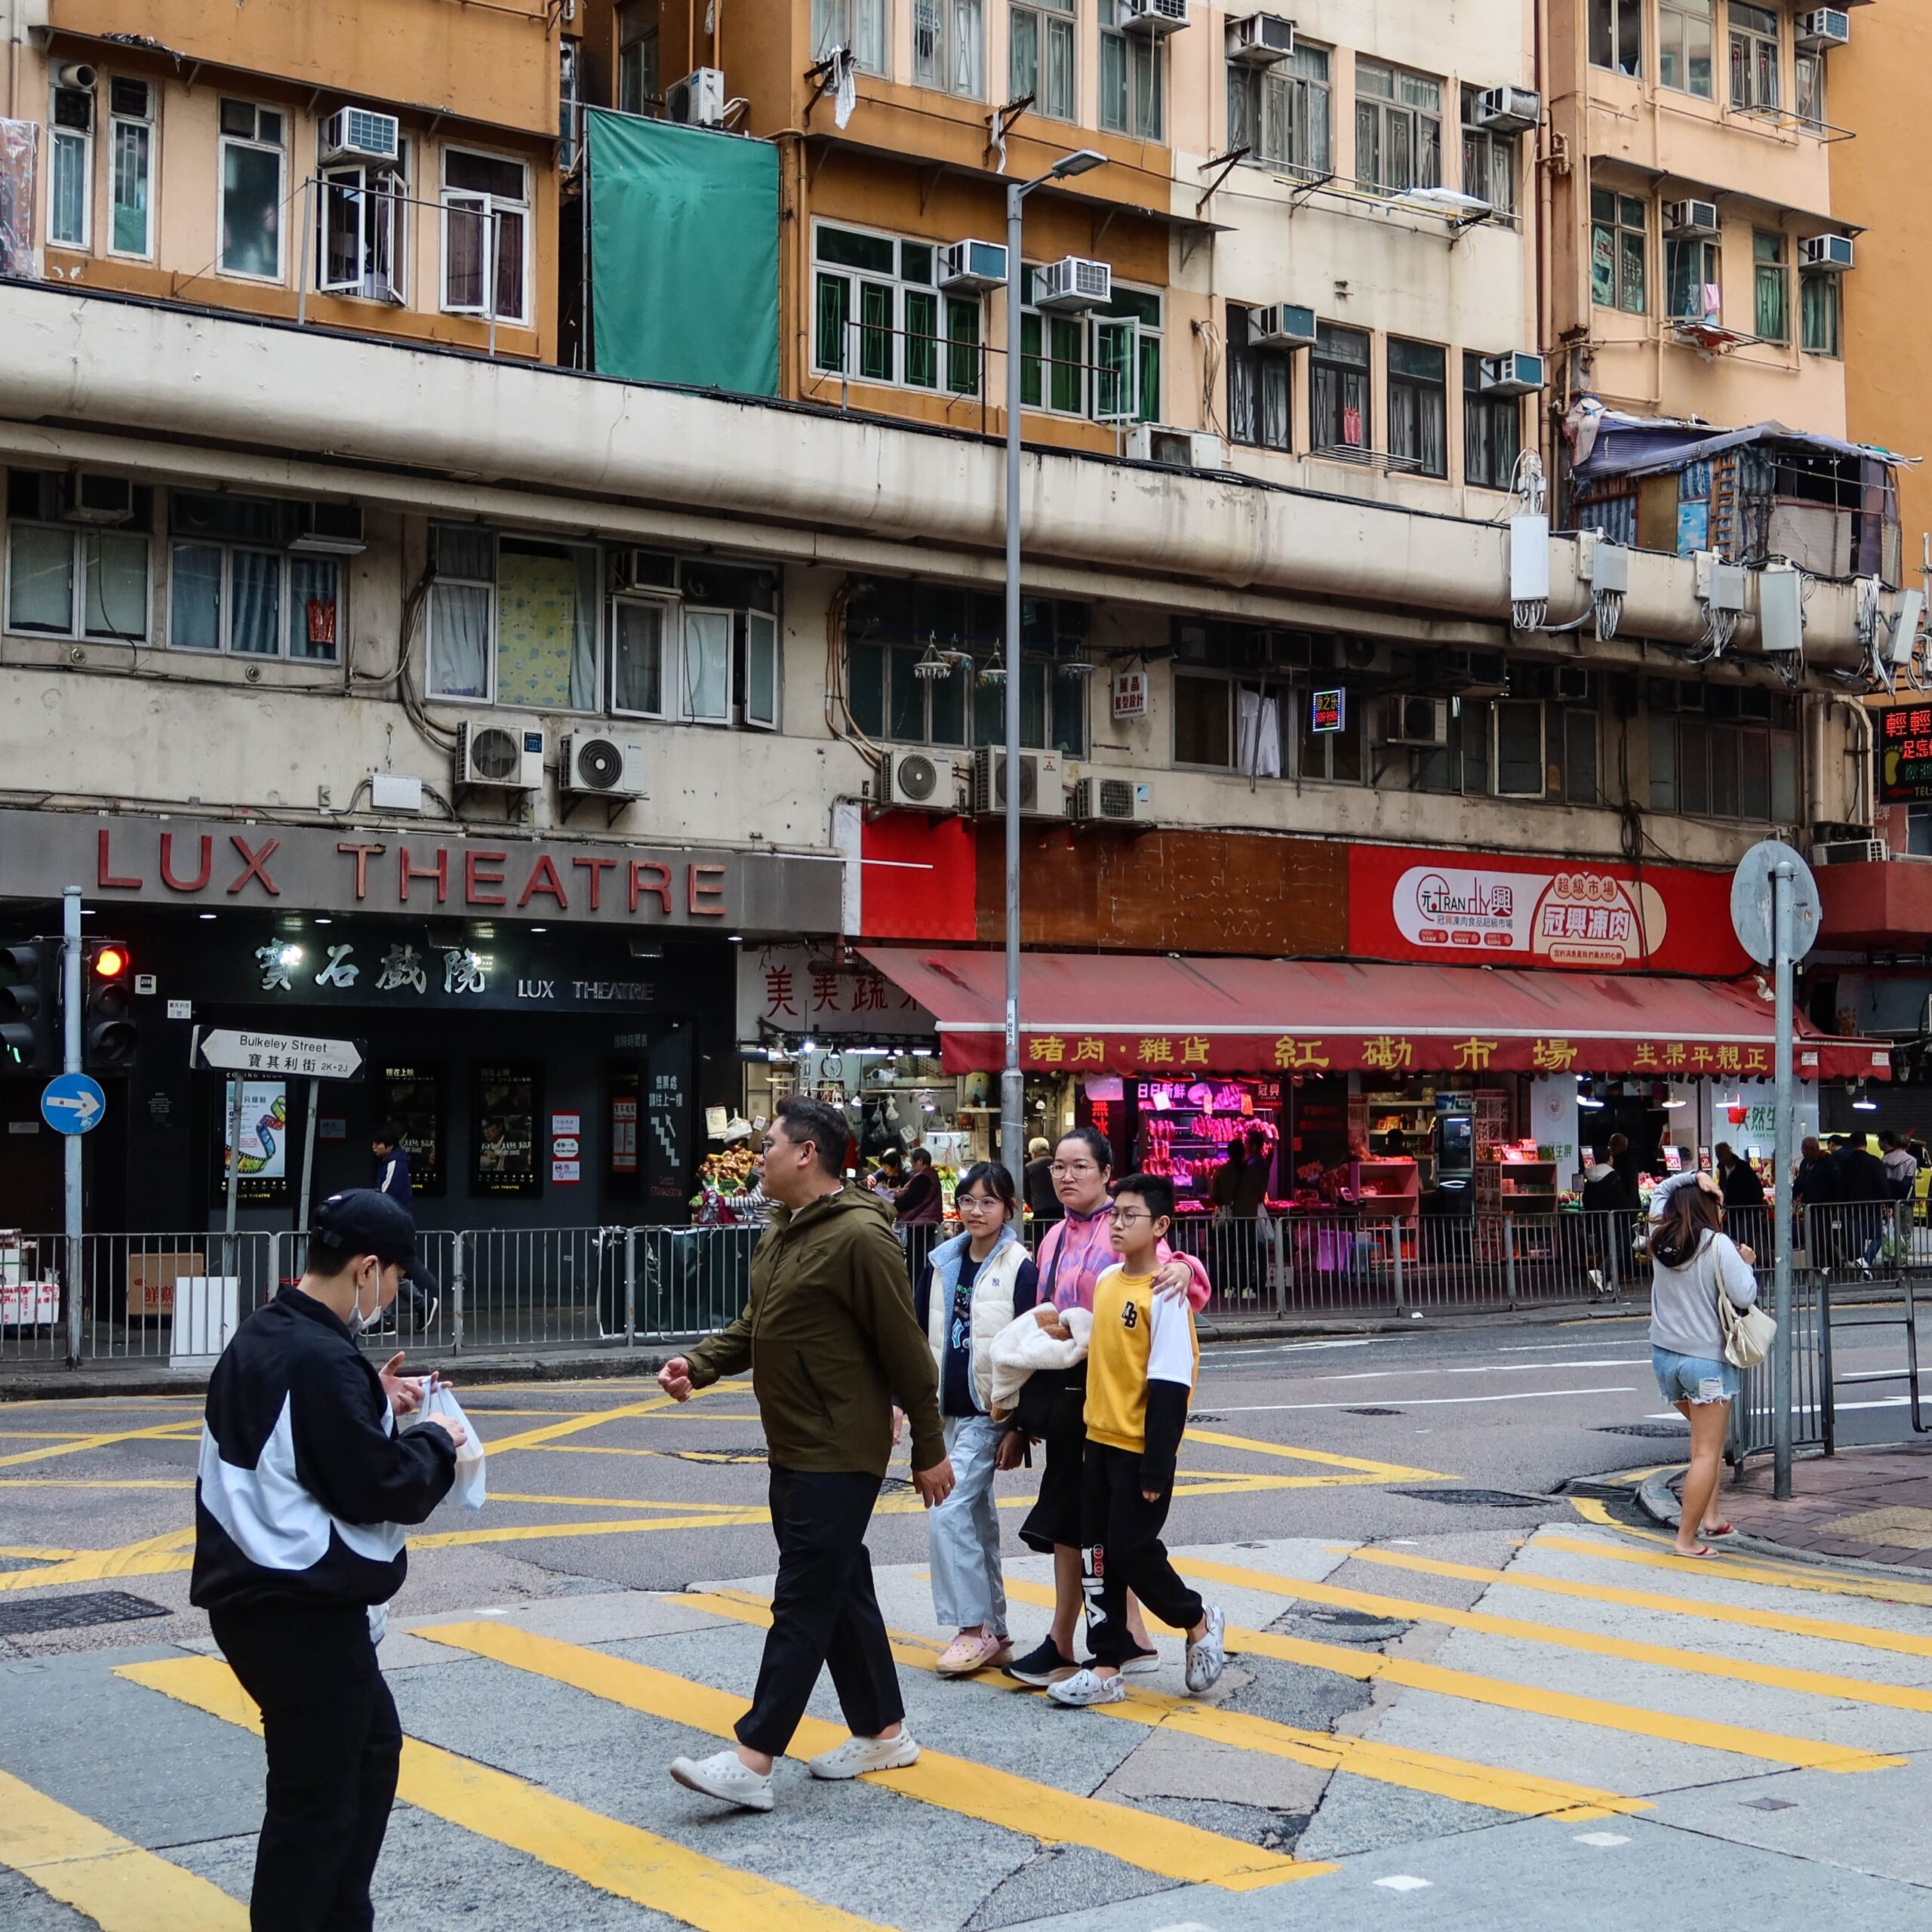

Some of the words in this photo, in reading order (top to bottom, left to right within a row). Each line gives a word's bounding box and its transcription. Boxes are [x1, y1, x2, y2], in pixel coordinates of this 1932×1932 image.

[97, 829, 281, 896] LUX
[337, 842, 728, 916] THEATRE
[1557, 876, 1615, 897] 超級市場
[518, 979, 555, 998] LUX
[572, 980, 655, 1001] THEATRE
[240, 1035, 288, 1051] Bulkeley
[291, 1039, 328, 1054] Street
[1275, 1035, 1577, 1070] 紅磡市場
[248, 1053, 316, 1072] 寶其利街
[1633, 1043, 1768, 1071] 生果平靚正
[655, 1075, 678, 1091] 售票處
[649, 1093, 683, 1108] 請往上一樓
